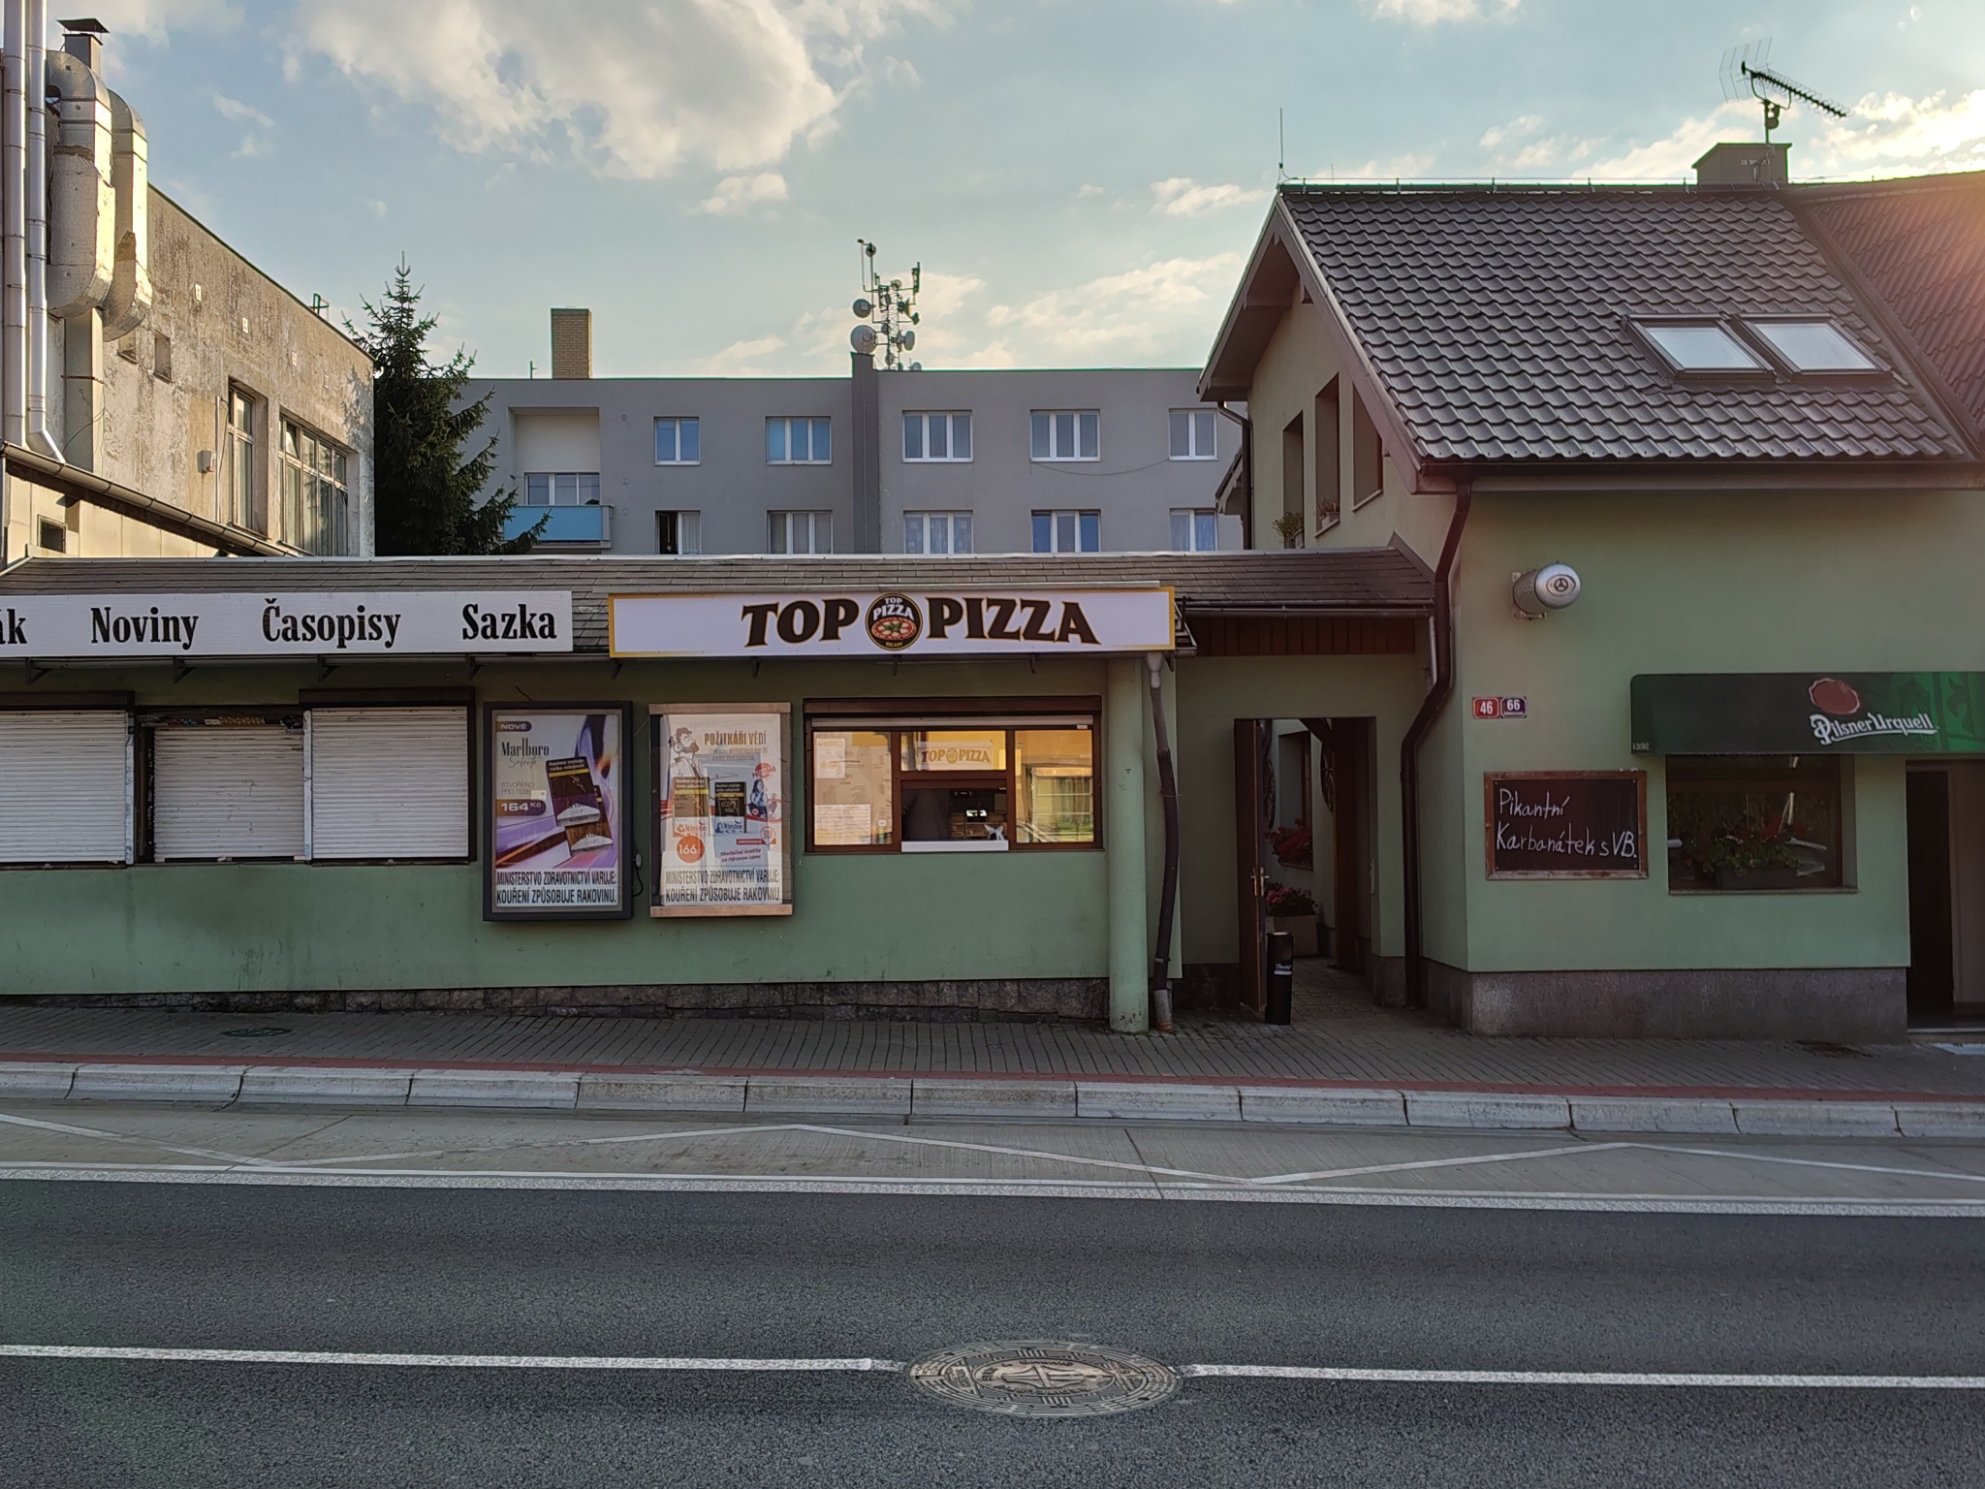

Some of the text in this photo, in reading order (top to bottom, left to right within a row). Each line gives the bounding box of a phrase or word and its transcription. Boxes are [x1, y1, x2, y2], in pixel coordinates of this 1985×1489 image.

[873, 604, 914, 621] PIZZA
[91, 607, 199, 650] Noviny
[262, 598, 401, 649] Časopisy
[462, 603, 557, 640] Sazka
[741, 597, 1102, 648] TOP PIZZA
[1480, 701, 1493, 715] 46
[1507, 700, 1520, 711] 66
[1809, 712, 1933, 745] Pilsner Urquell
[704, 730, 767, 746] POŽITKÁŘI VĚDÍ
[501, 738, 549, 757] Marlboro
[921, 749, 992, 764] TOP PIZZA
[501, 802, 529, 812] 164
[1500, 788, 1570, 819] Pikantní
[1496, 821, 1595, 855] Karbanátek
[497, 868, 617, 885] MINISTERSTVO ZDRAVOTNICTVÍ VARUJE:
[666, 870, 708, 885] MINISTERSTVO
[709, 867, 755, 884] ZDRAVOTNICTVÍ
[497, 887, 530, 904] KOUŘENÍ
[532, 887, 575, 903] ZPŮSOBUJE
[666, 886, 698, 902] KOUŘENÍ
[700, 886, 741, 902] ZPŮSOBUJE
